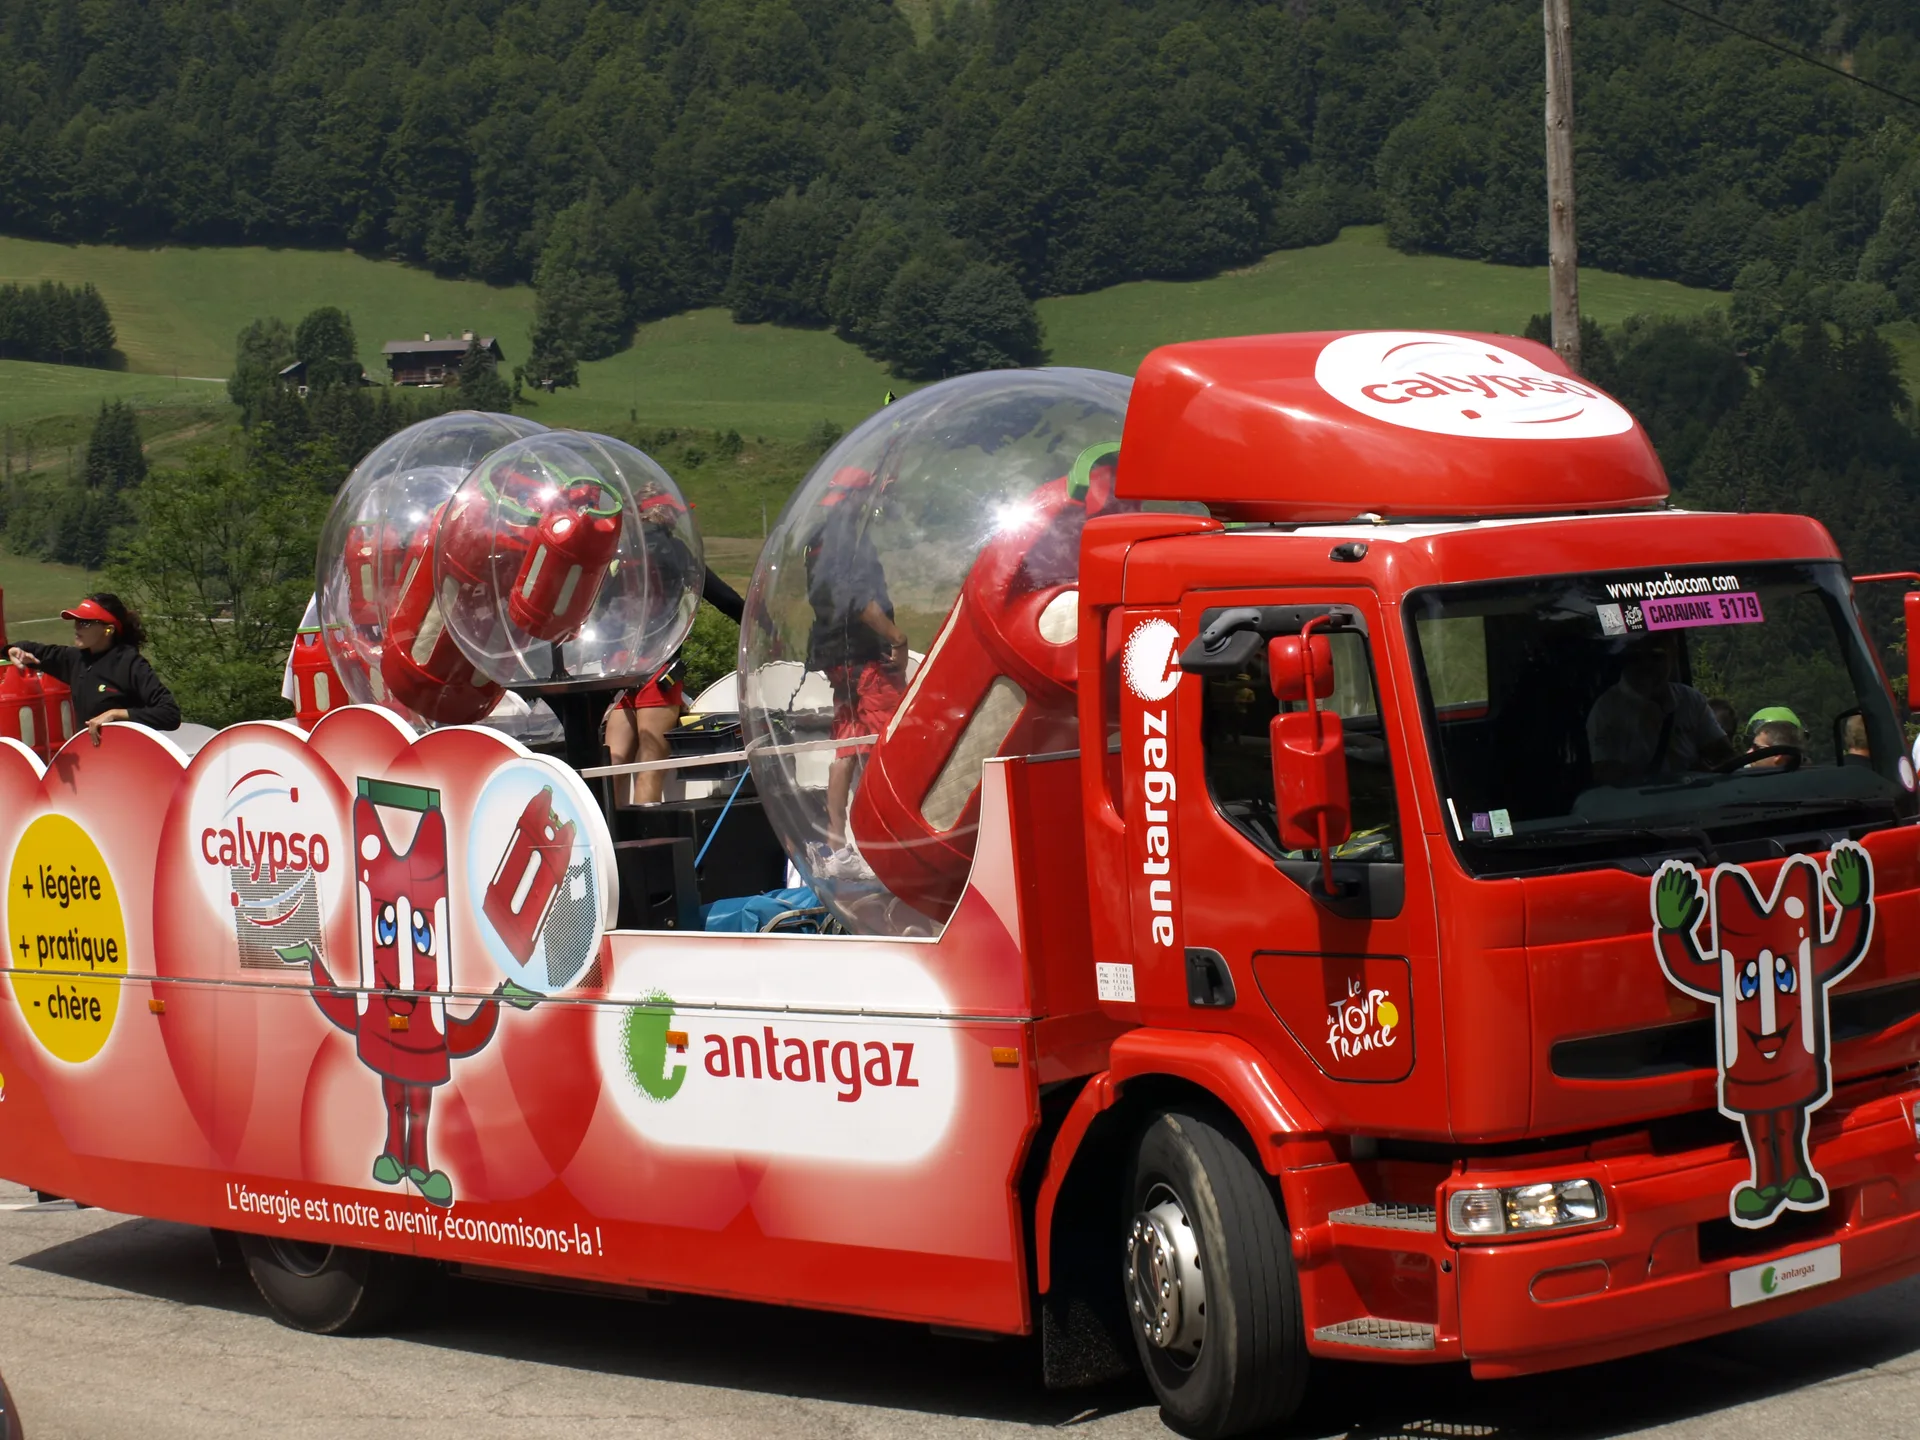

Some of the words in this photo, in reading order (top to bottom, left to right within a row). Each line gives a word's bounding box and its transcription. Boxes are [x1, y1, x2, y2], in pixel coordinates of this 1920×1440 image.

[1361, 372, 1598, 404] calypso
[1649, 601, 1713, 624] CARAVANE
[1718, 596, 1759, 619] 5179
[201, 816, 330, 883] calypso
[1143, 709, 1177, 948] antargaz
[39, 865, 102, 909] légère
[36, 927, 119, 971] pratique
[47, 985, 102, 1022] chère
[703, 1025, 920, 1103] antargaz
[225, 1182, 301, 1224] L'énergie
[304, 1199, 330, 1223] est
[333, 1203, 380, 1229] notre
[1780, 1263, 1816, 1281] antargaz
